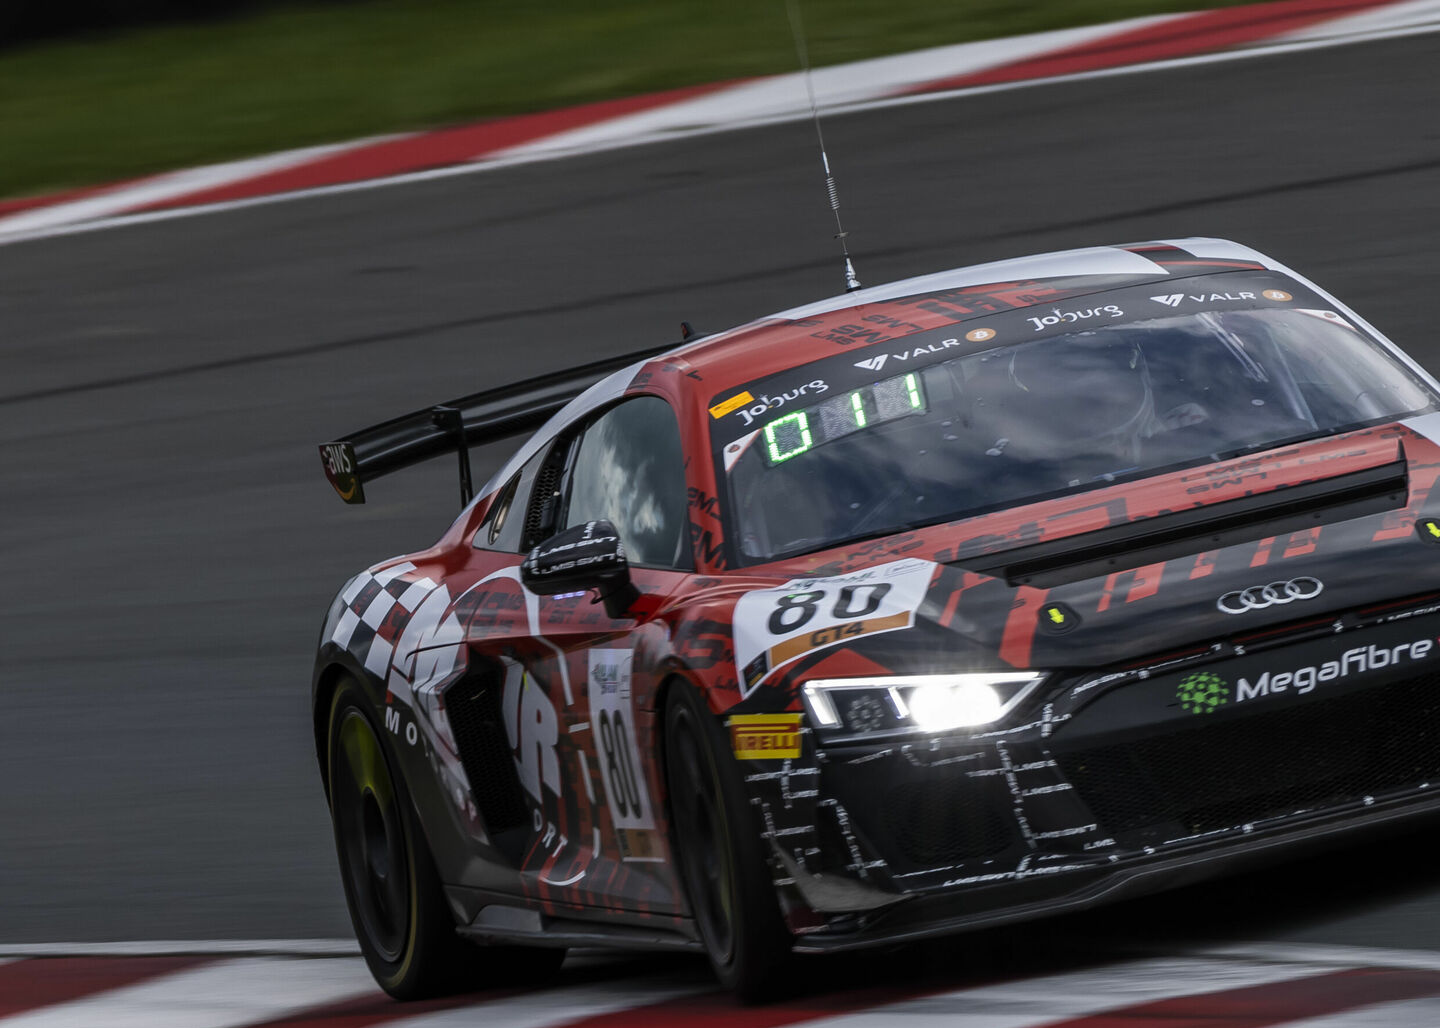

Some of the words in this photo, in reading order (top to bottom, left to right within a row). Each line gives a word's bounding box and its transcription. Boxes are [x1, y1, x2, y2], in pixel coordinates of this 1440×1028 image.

[1188, 291, 1257, 304] VALR
[893, 338, 960, 361] VALR
[769, 583, 892, 635] 80
[810, 622, 864, 647] GT4
[1235, 639, 1433, 703] Megafibre
[599, 708, 641, 819] 80
